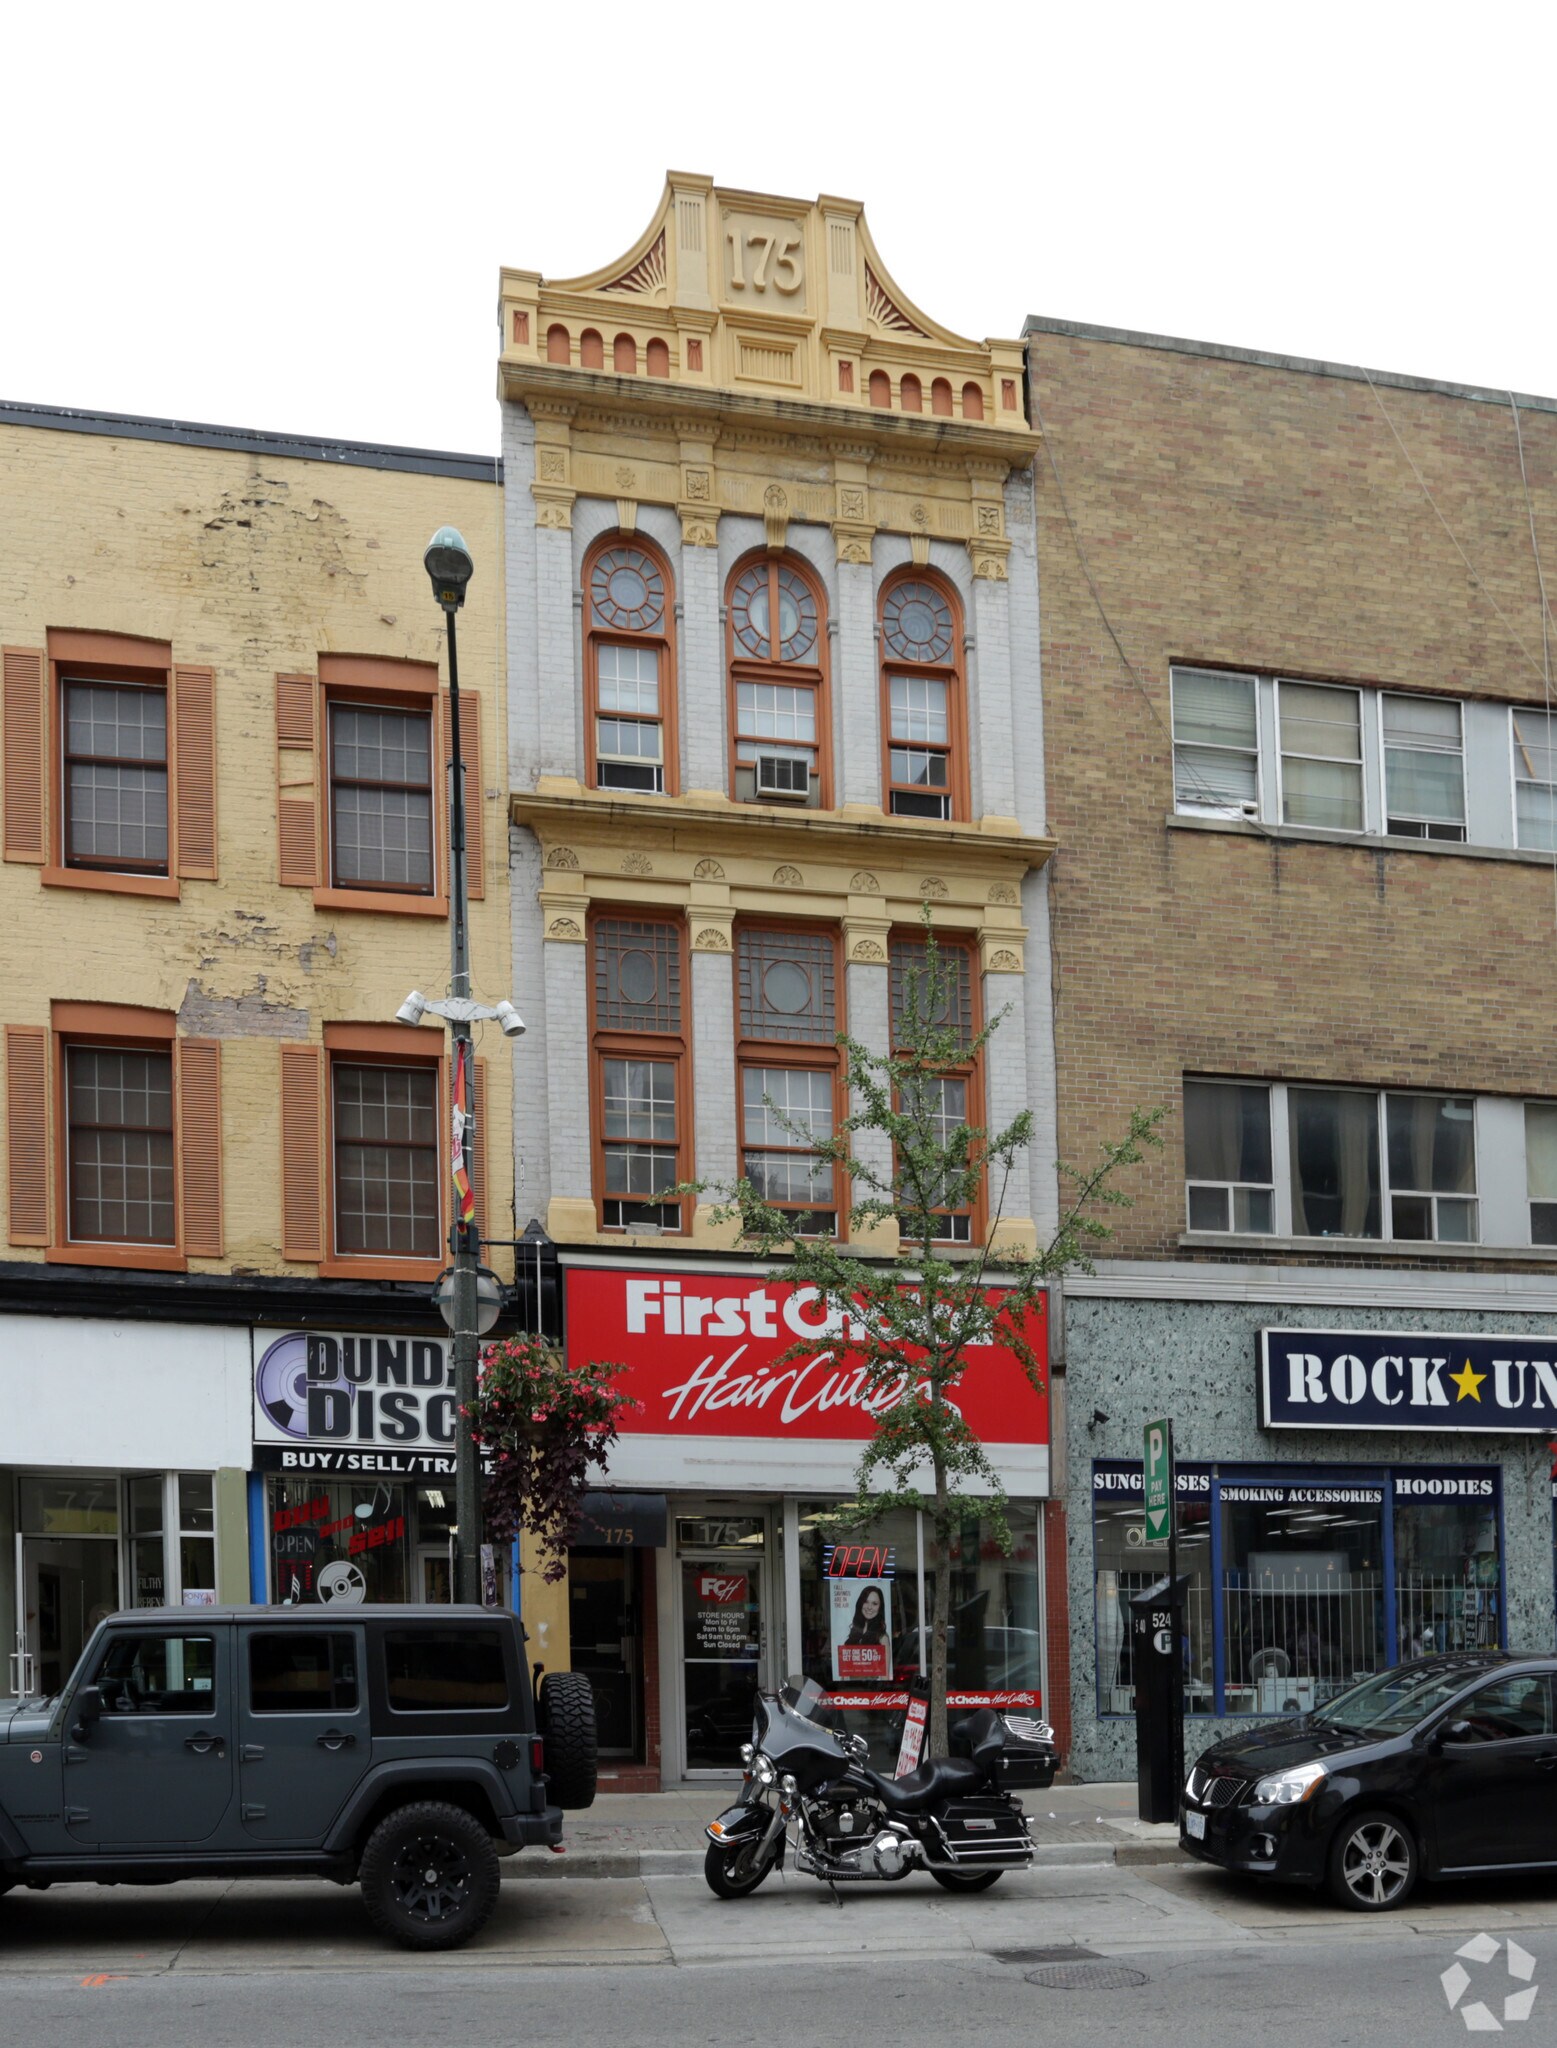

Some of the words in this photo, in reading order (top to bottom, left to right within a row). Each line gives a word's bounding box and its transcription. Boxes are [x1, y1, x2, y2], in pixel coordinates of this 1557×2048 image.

[727, 228, 802, 296] 175
[626, 1279, 777, 1338] First
[1286, 1353, 1450, 1406] ROCK
[1150, 1428, 1163, 1477] P
[282, 1452, 497, 1475] BUY/SELL/TRE
[1094, 1473, 1210, 1491] SUNGSES
[1151, 1479, 1162, 1493] PAY
[1395, 1478, 1493, 1495] HOODIES
[1148, 1492, 1166, 1507] HERE
[1219, 1487, 1284, 1501] SMOKING
[1287, 1488, 1382, 1503] ACCESSORIES
[605, 1528, 634, 1545] 175
[699, 1522, 741, 1546] 175
[273, 1535, 316, 1553] OPEN
[829, 1546, 888, 1577] OPEN
[726, 1626, 741, 1634] 6pm
[732, 1634, 747, 1642] 6pm
[717, 1641, 741, 1649] Closed
[833, 1695, 870, 1706] Choice
[955, 1695, 990, 1705] Choice
